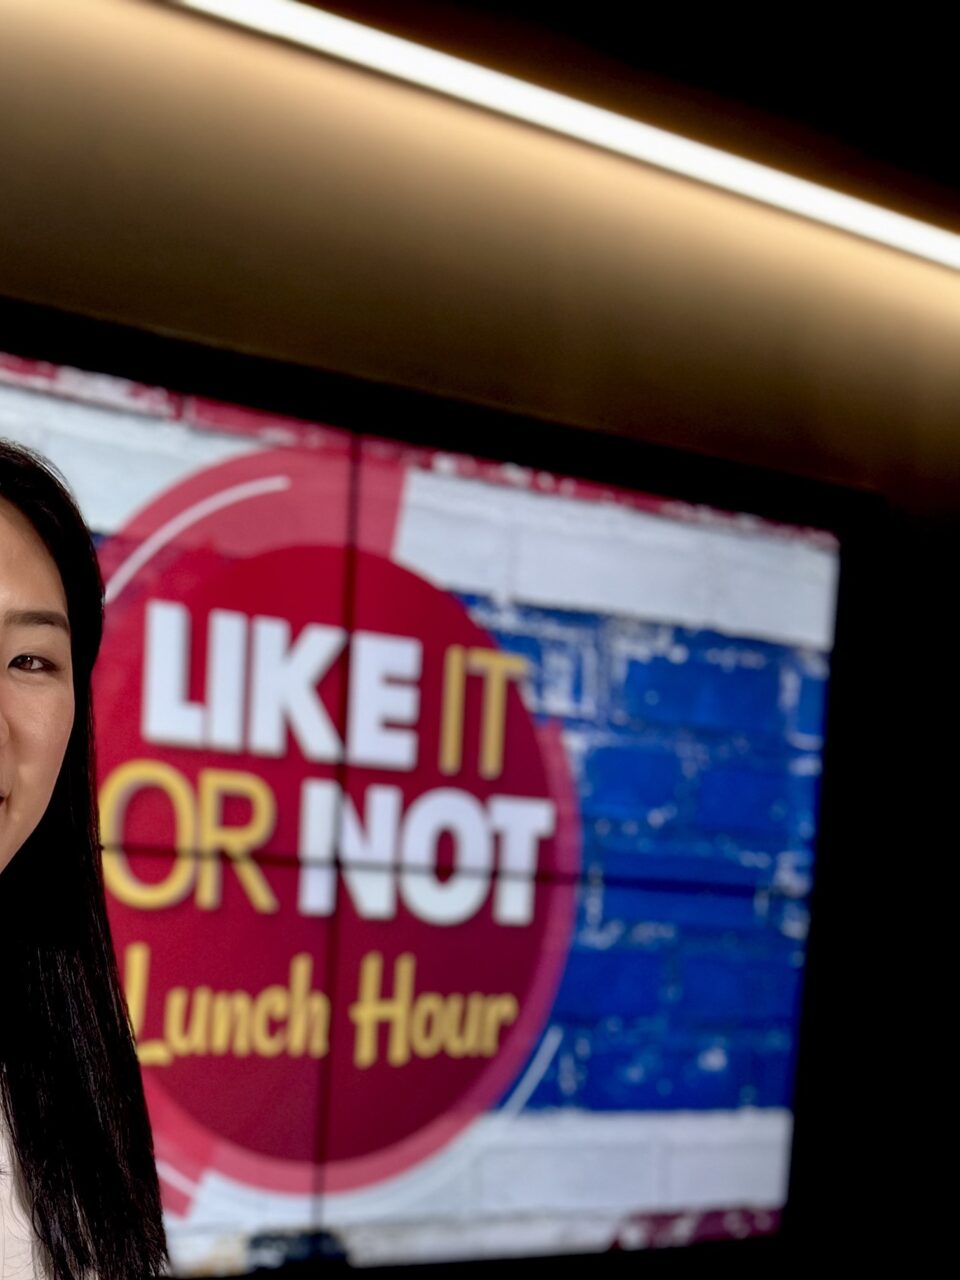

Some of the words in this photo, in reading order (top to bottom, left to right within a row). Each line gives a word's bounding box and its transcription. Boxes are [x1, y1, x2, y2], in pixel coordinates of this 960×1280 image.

[142, 600, 423, 771] LIKE
[440, 644, 529, 778] IT
[98, 759, 278, 913] OR
[297, 778, 556, 927] NOT
[124, 941, 330, 1065] Lunch
[350, 952, 518, 1068] Hour
